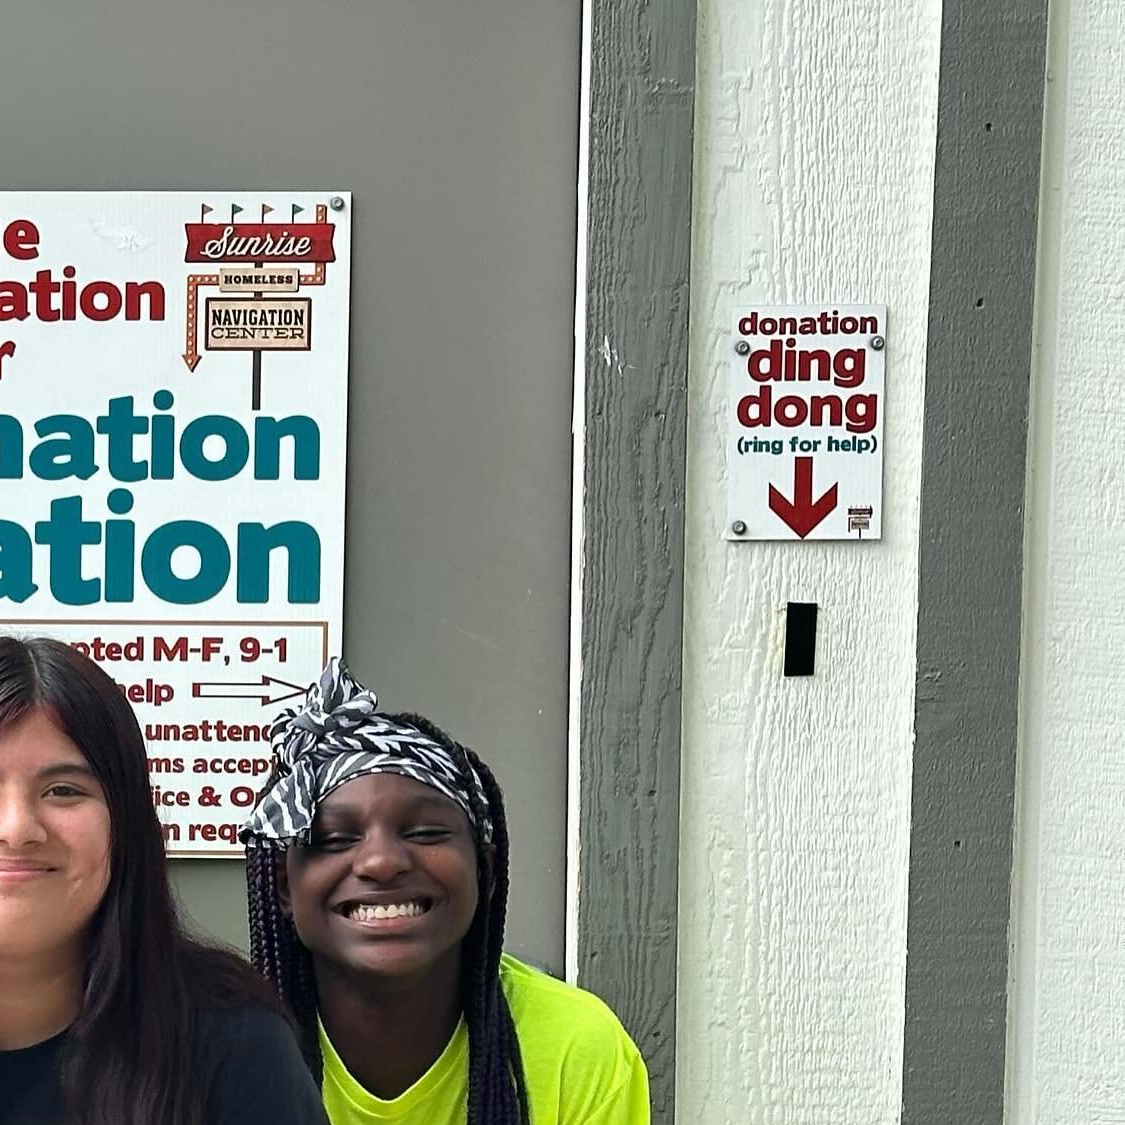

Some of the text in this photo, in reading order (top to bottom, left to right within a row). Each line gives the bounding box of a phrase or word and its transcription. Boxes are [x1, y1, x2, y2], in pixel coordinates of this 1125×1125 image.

[200, 226, 311, 258] Sunrise
[224, 275, 293, 285] HOMELESS
[212, 309, 305, 326] NAVIGATION
[738, 310, 878, 336] donation
[211, 327, 305, 339] CENTER
[747, 338, 866, 388] ding
[737, 385, 878, 434] dong
[737, 435, 878, 455] (ring for help)
[153, 637, 230, 666] M-F,
[239, 636, 287, 662] 9-1
[116, 678, 174, 706] elp
[151, 785, 261, 807] ice & O
[189, 823, 242, 844] req
